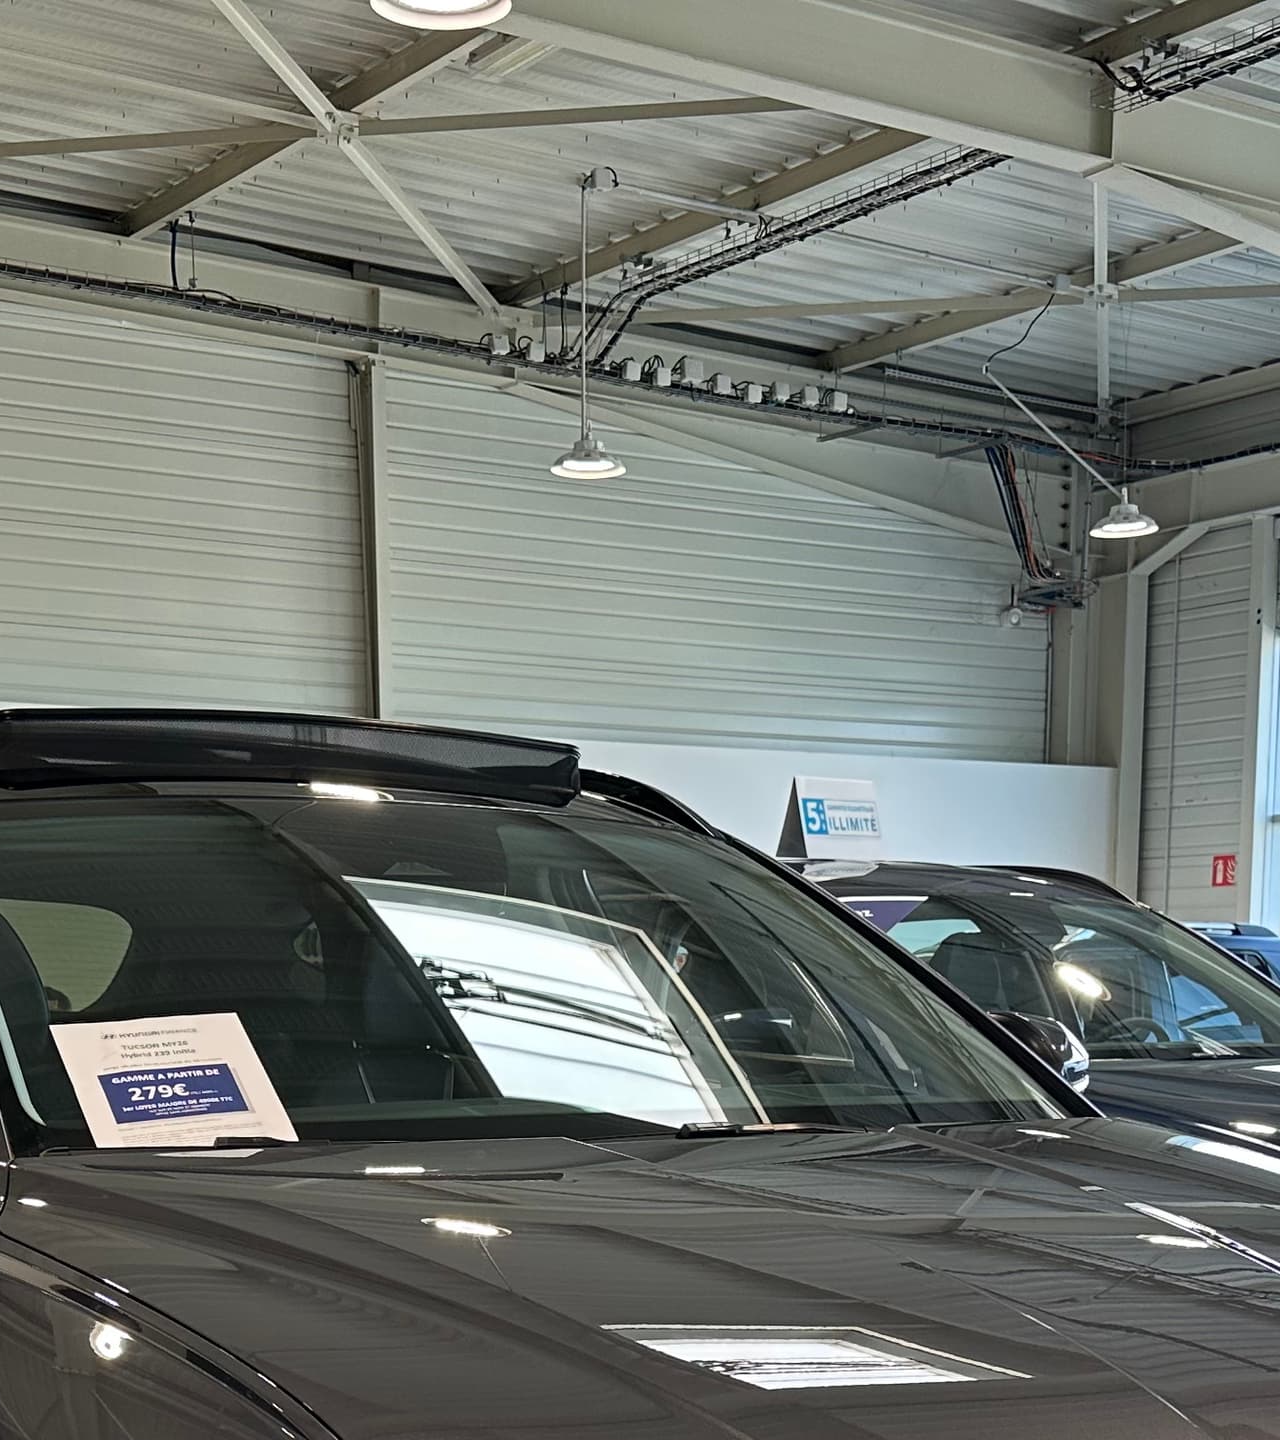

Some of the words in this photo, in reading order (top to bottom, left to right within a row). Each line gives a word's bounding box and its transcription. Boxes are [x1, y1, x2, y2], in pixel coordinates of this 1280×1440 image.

[806, 801, 821, 832] 5
[828, 815, 878, 832] ILLIMITÉ
[111, 1073, 156, 1084] GAMME
[166, 1070, 205, 1080] PARTIR
[128, 1083, 190, 1102] 279€
